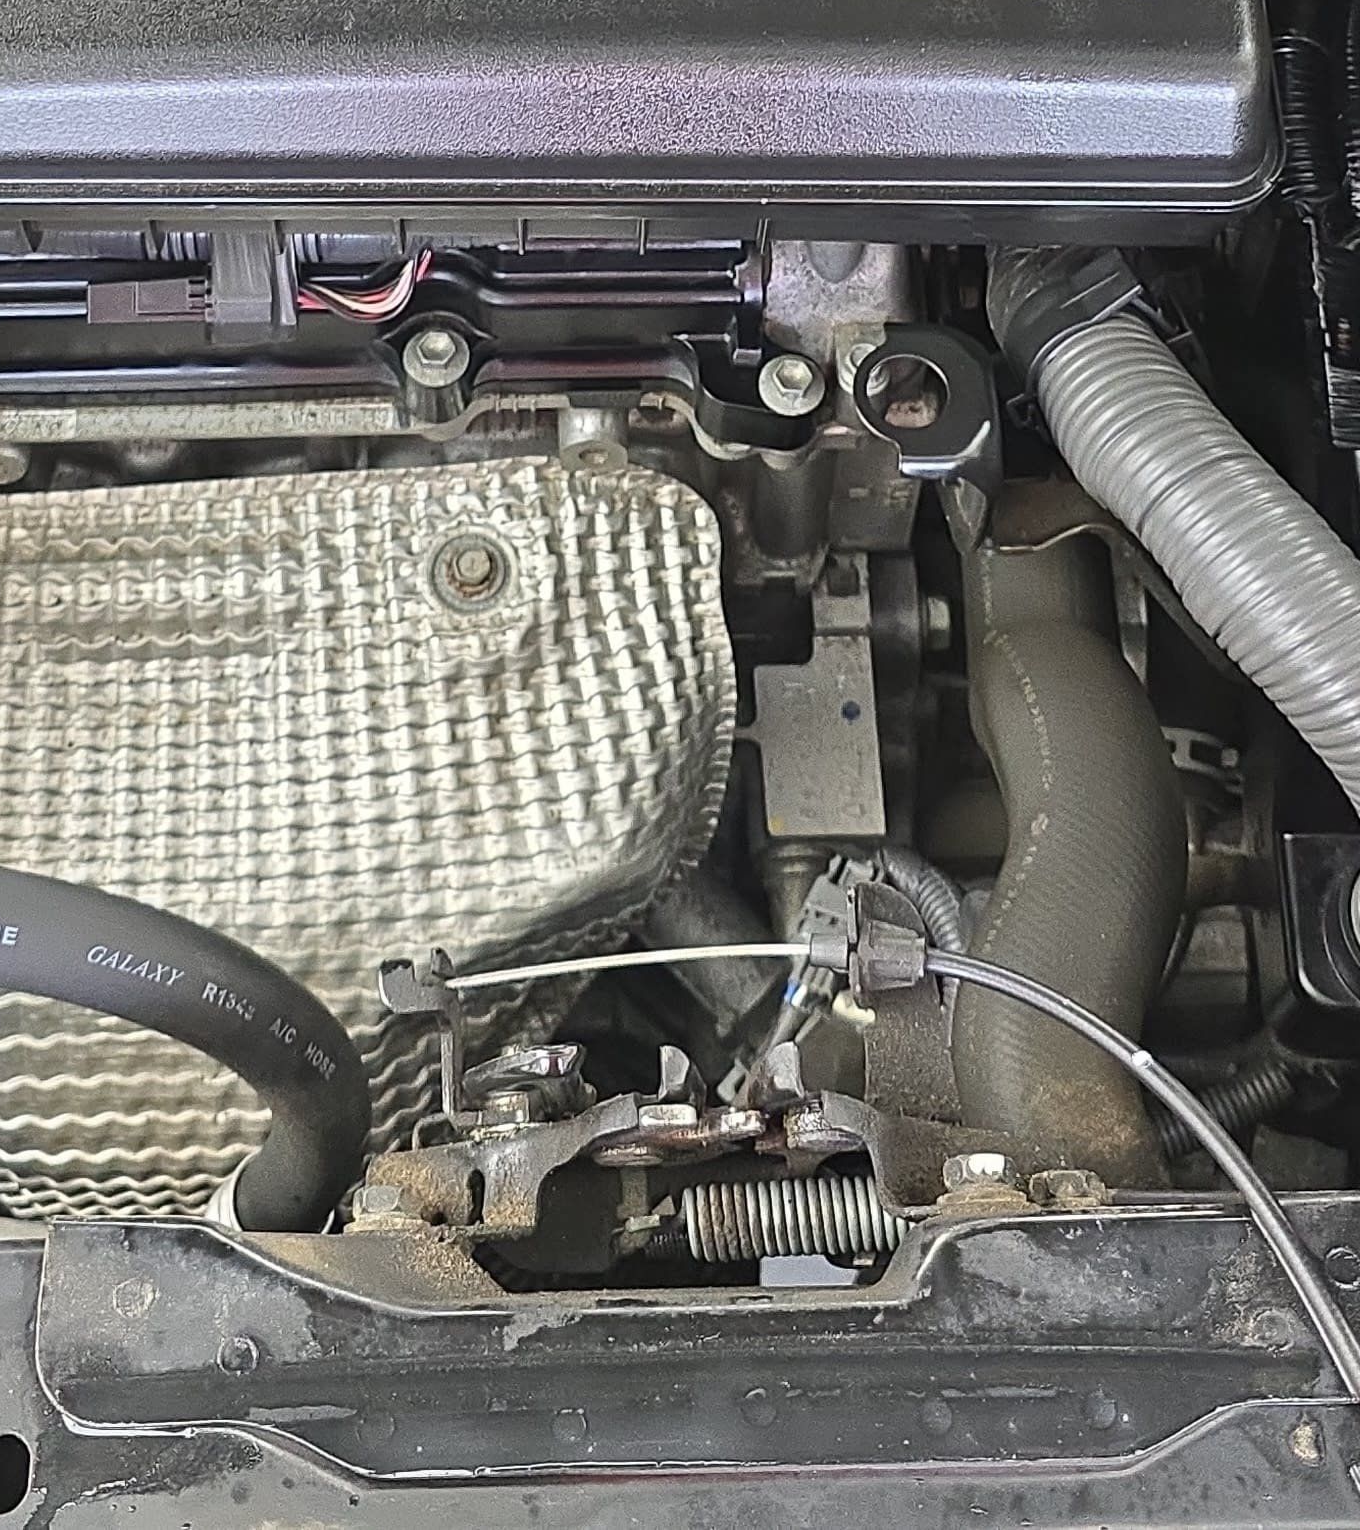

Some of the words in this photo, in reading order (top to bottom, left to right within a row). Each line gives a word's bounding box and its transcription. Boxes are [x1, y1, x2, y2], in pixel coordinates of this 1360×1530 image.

[86, 944, 185, 988] GALAXY
[268, 1017, 298, 1046] A/C
[303, 1039, 339, 1082] HOSE
